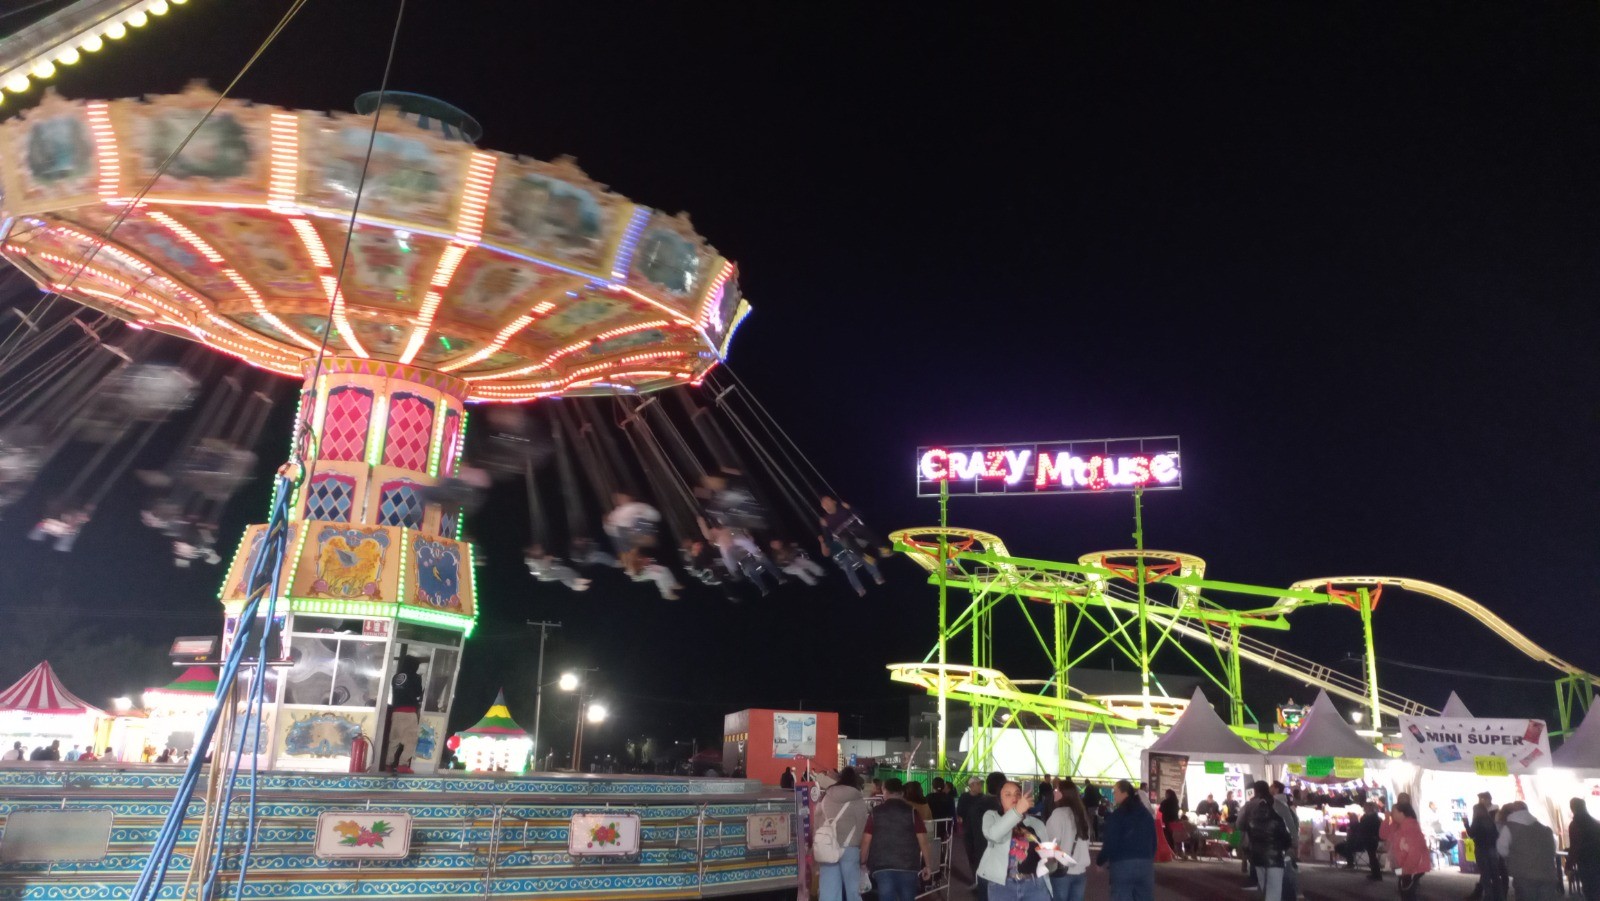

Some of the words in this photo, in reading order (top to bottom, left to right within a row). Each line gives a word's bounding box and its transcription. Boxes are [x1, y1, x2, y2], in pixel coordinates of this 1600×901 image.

[1036, 451, 1179, 489] Mouse
[1426, 732, 1462, 744] MINI
[1468, 733, 1524, 746] SUPER
